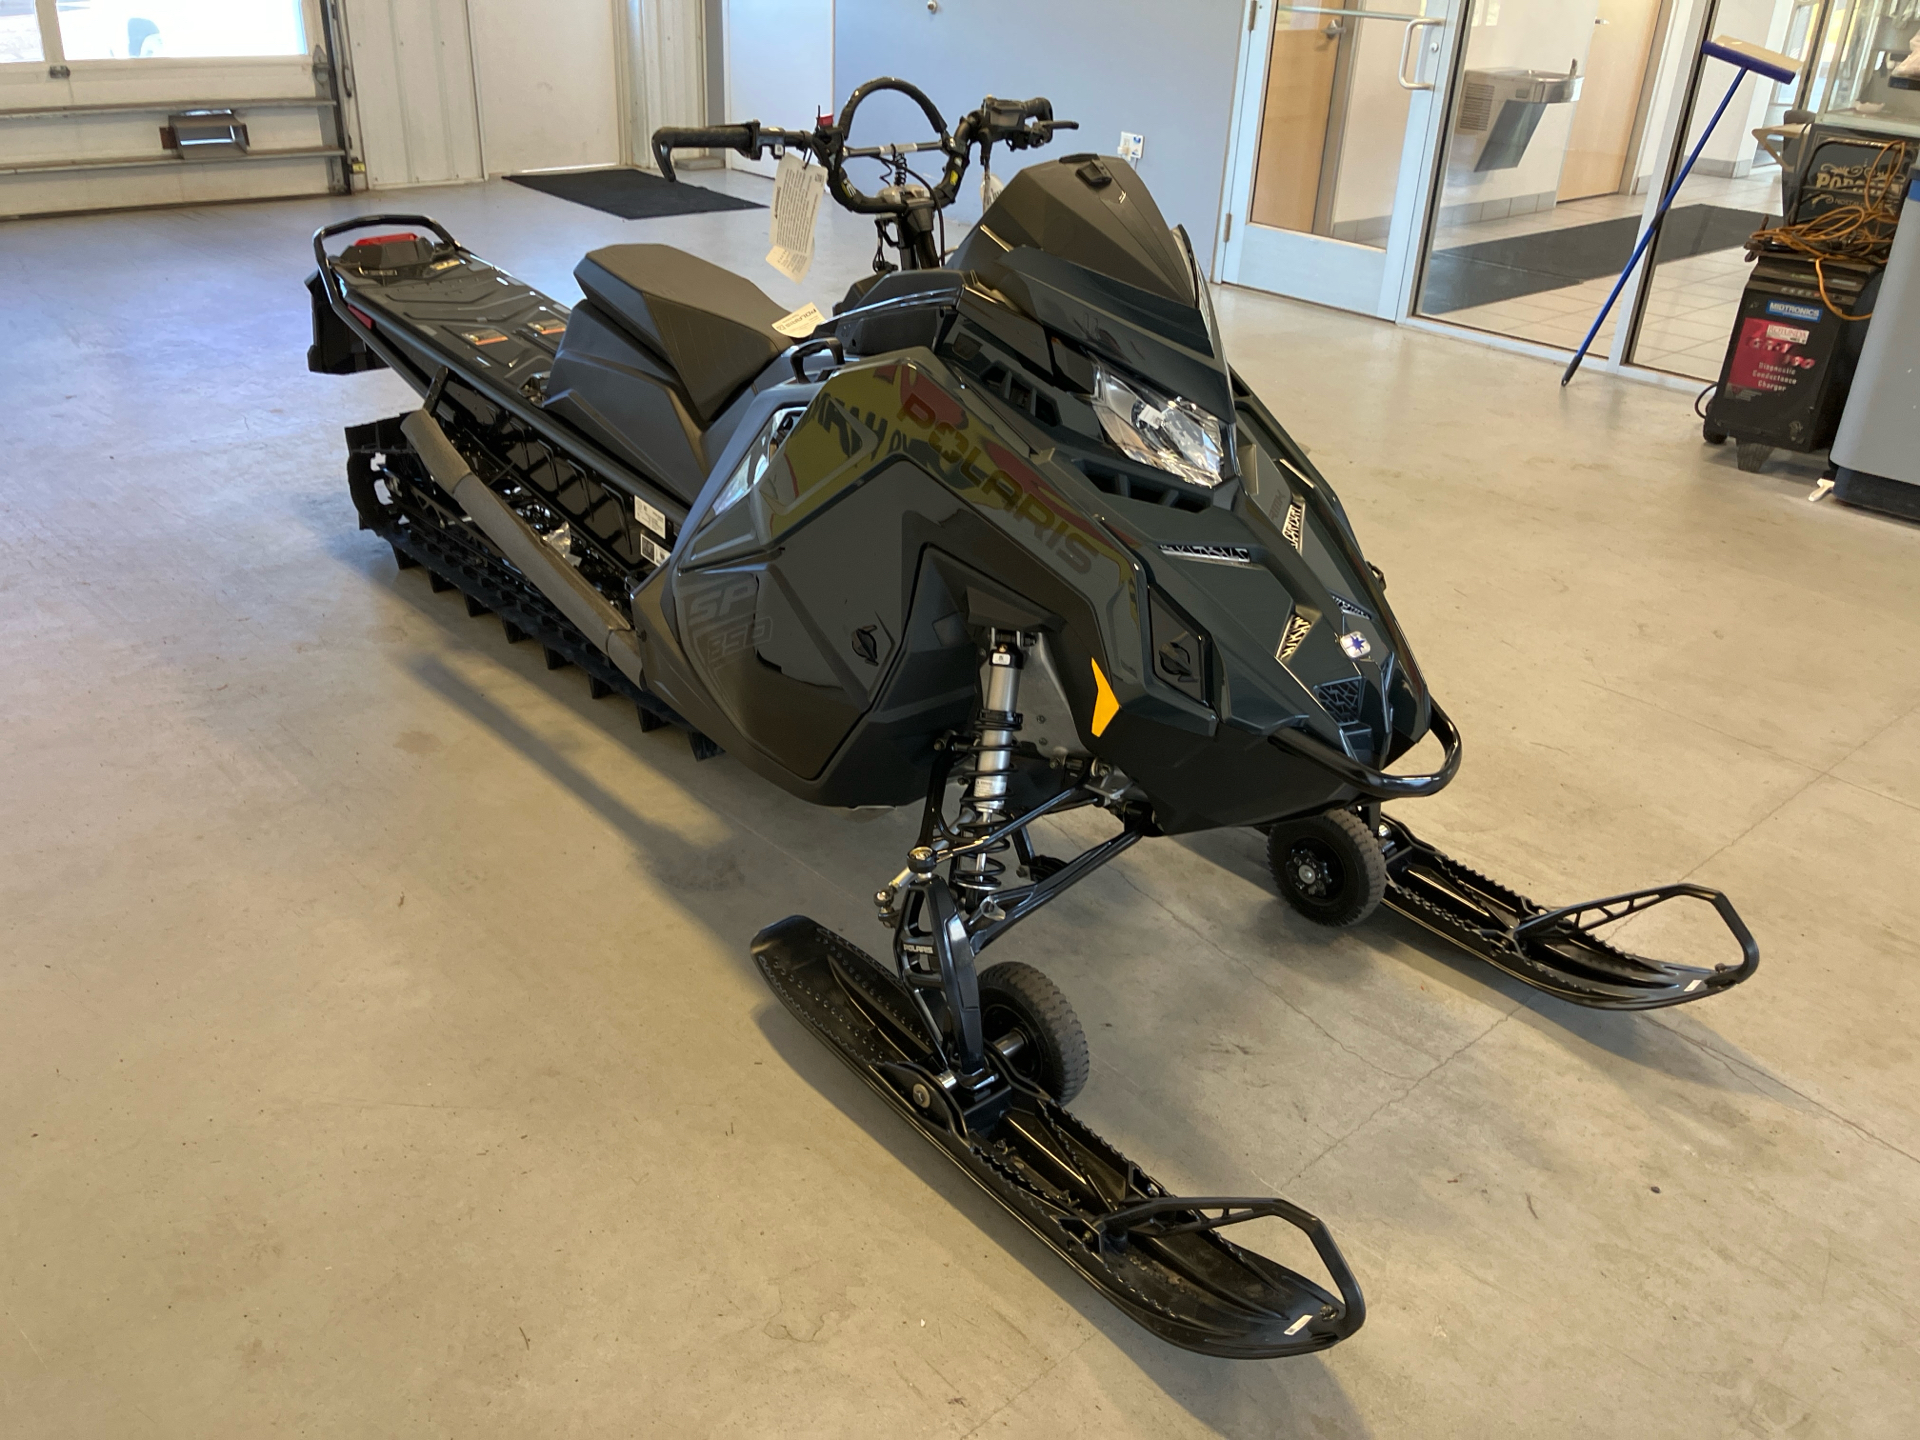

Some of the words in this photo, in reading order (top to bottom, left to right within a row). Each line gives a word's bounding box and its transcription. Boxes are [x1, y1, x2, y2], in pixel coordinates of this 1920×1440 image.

[1769, 302, 1820, 317] MIDTRONICS
[1758, 362, 1796, 376] Diagnostic
[1752, 370, 1797, 385] Conductance
[1757, 380, 1787, 392] Charger
[897, 392, 1099, 574] POLARIS
[688, 581, 758, 626] SP
[903, 943, 934, 954] POLARIS
